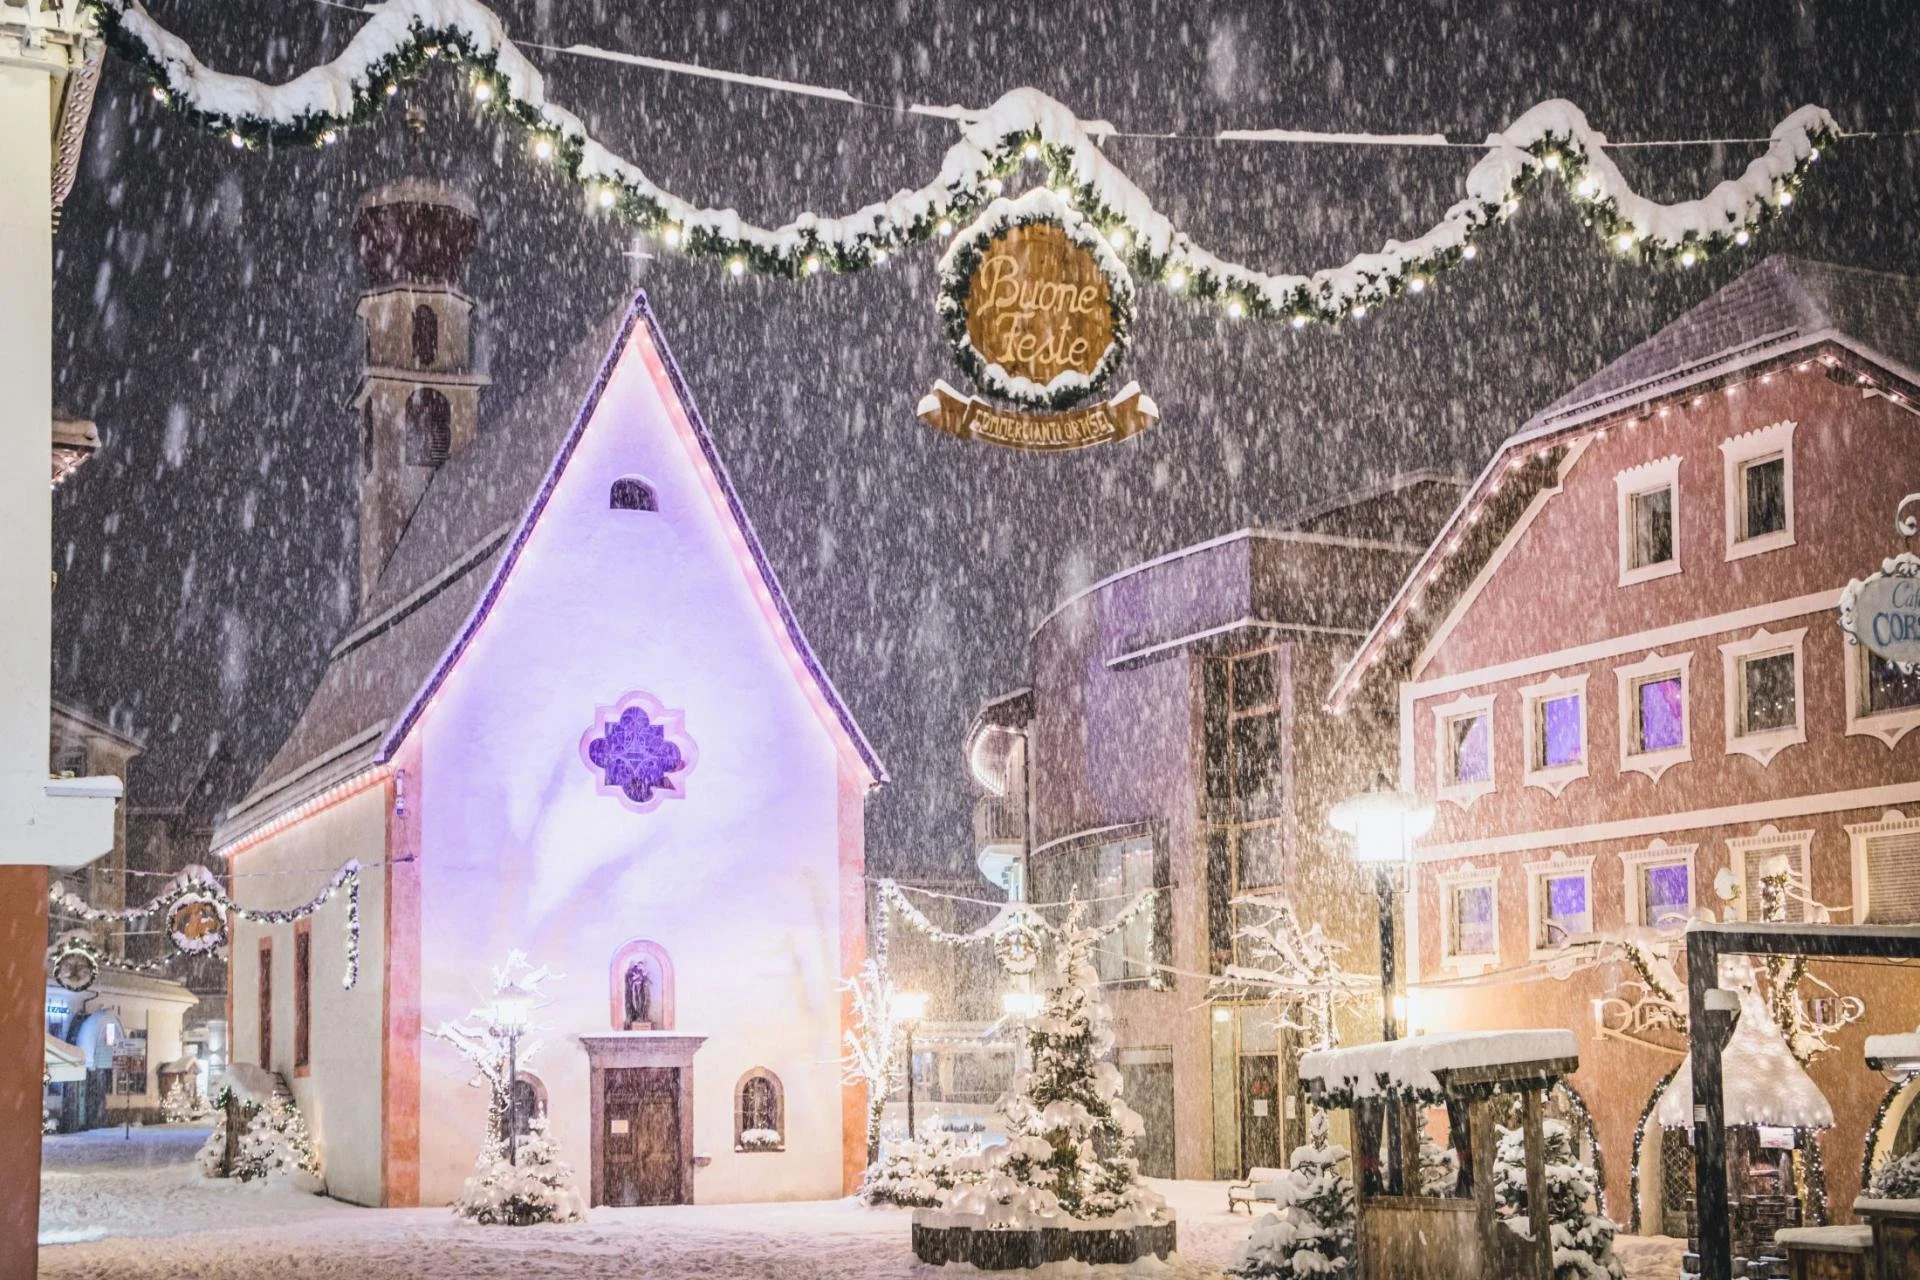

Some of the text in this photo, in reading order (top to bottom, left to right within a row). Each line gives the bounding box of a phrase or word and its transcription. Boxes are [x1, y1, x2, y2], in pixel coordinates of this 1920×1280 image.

[977, 254, 1098, 316] Buone
[996, 312, 1088, 365] Feste
[1892, 580, 1920, 609] Caf
